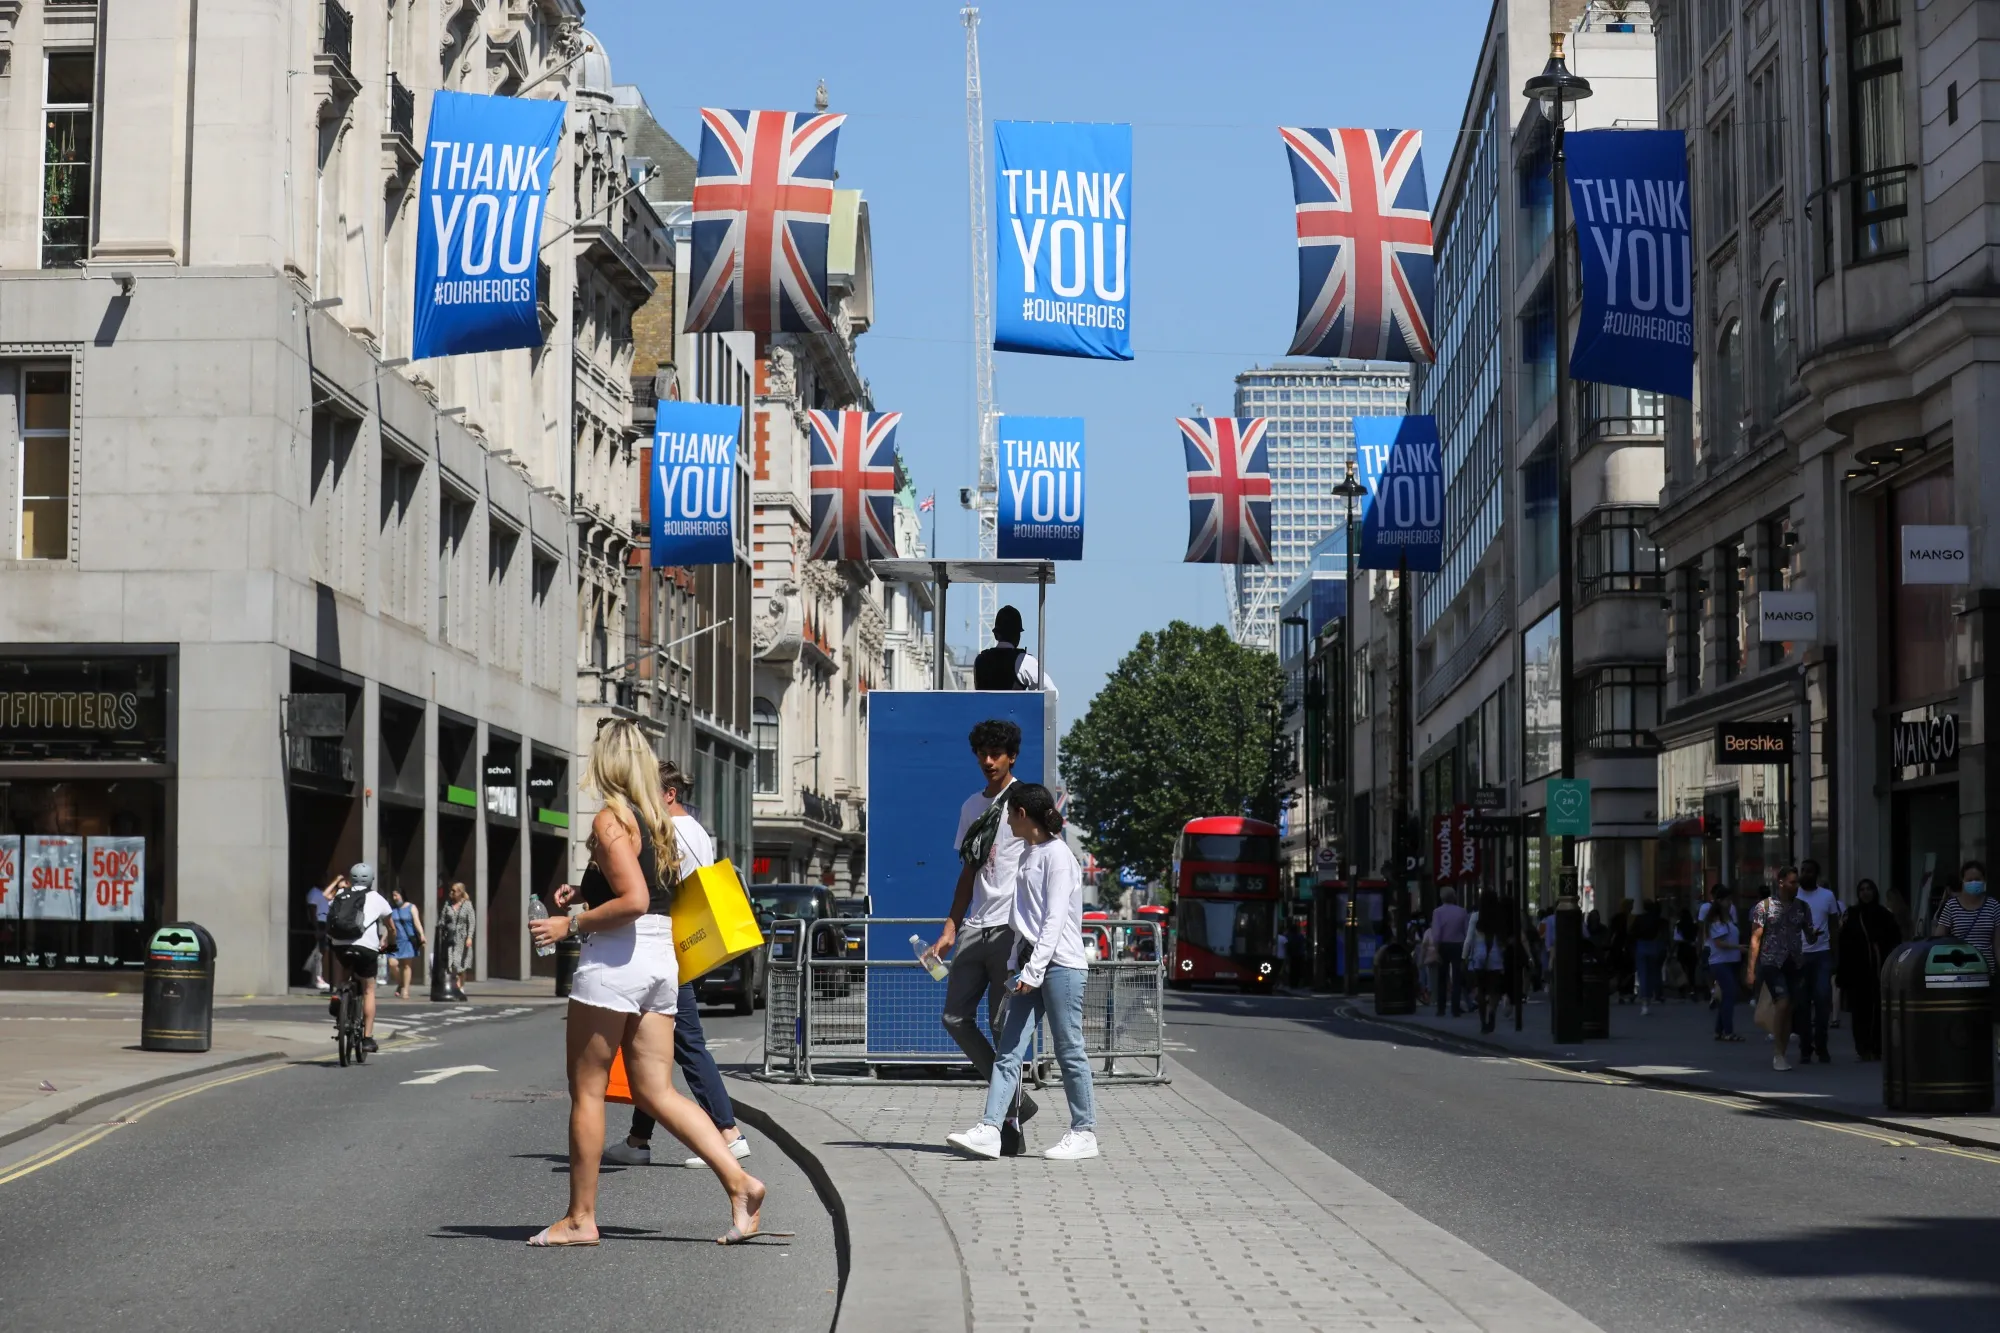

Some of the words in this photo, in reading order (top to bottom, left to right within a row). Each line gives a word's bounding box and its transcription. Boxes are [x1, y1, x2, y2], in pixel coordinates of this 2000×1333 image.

[431, 141, 549, 191] THANK
[1002, 169, 1126, 220] THANK
[1574, 178, 1688, 230] THANK
[431, 194, 540, 277] YOU
[1011, 218, 1126, 302] YOU
[1590, 226, 1691, 316] YOU
[434, 278, 530, 305] #OURHEROES
[1022, 298, 1125, 331] #OURHEROES
[1602, 310, 1692, 346] #OURHEROES
[1271, 376, 1342, 388] CENTRE
[658, 432, 734, 465] THANK
[1003, 440, 1081, 469] THANK
[1360, 443, 1438, 475] THANK
[659, 465, 730, 519] YOU
[1007, 469, 1081, 522] YOU
[1368, 475, 1440, 527] YOU
[664, 521, 728, 536] #OURHEROES
[1013, 523, 1080, 539] #OURHEROES
[1377, 530, 1441, 545] #OURHEROES
[1909, 549, 1964, 560] MANGO
[1764, 611, 1814, 621] MANGO
[1725, 735, 1784, 751] Bershka
[1893, 713, 1956, 768] MANGO
[487, 766, 511, 774] schuh
[31, 867, 74, 890] SALE
[92, 850, 139, 879] 50%
[96, 880, 134, 906] OFF
[680, 928, 707, 953] SELFRIDGES
